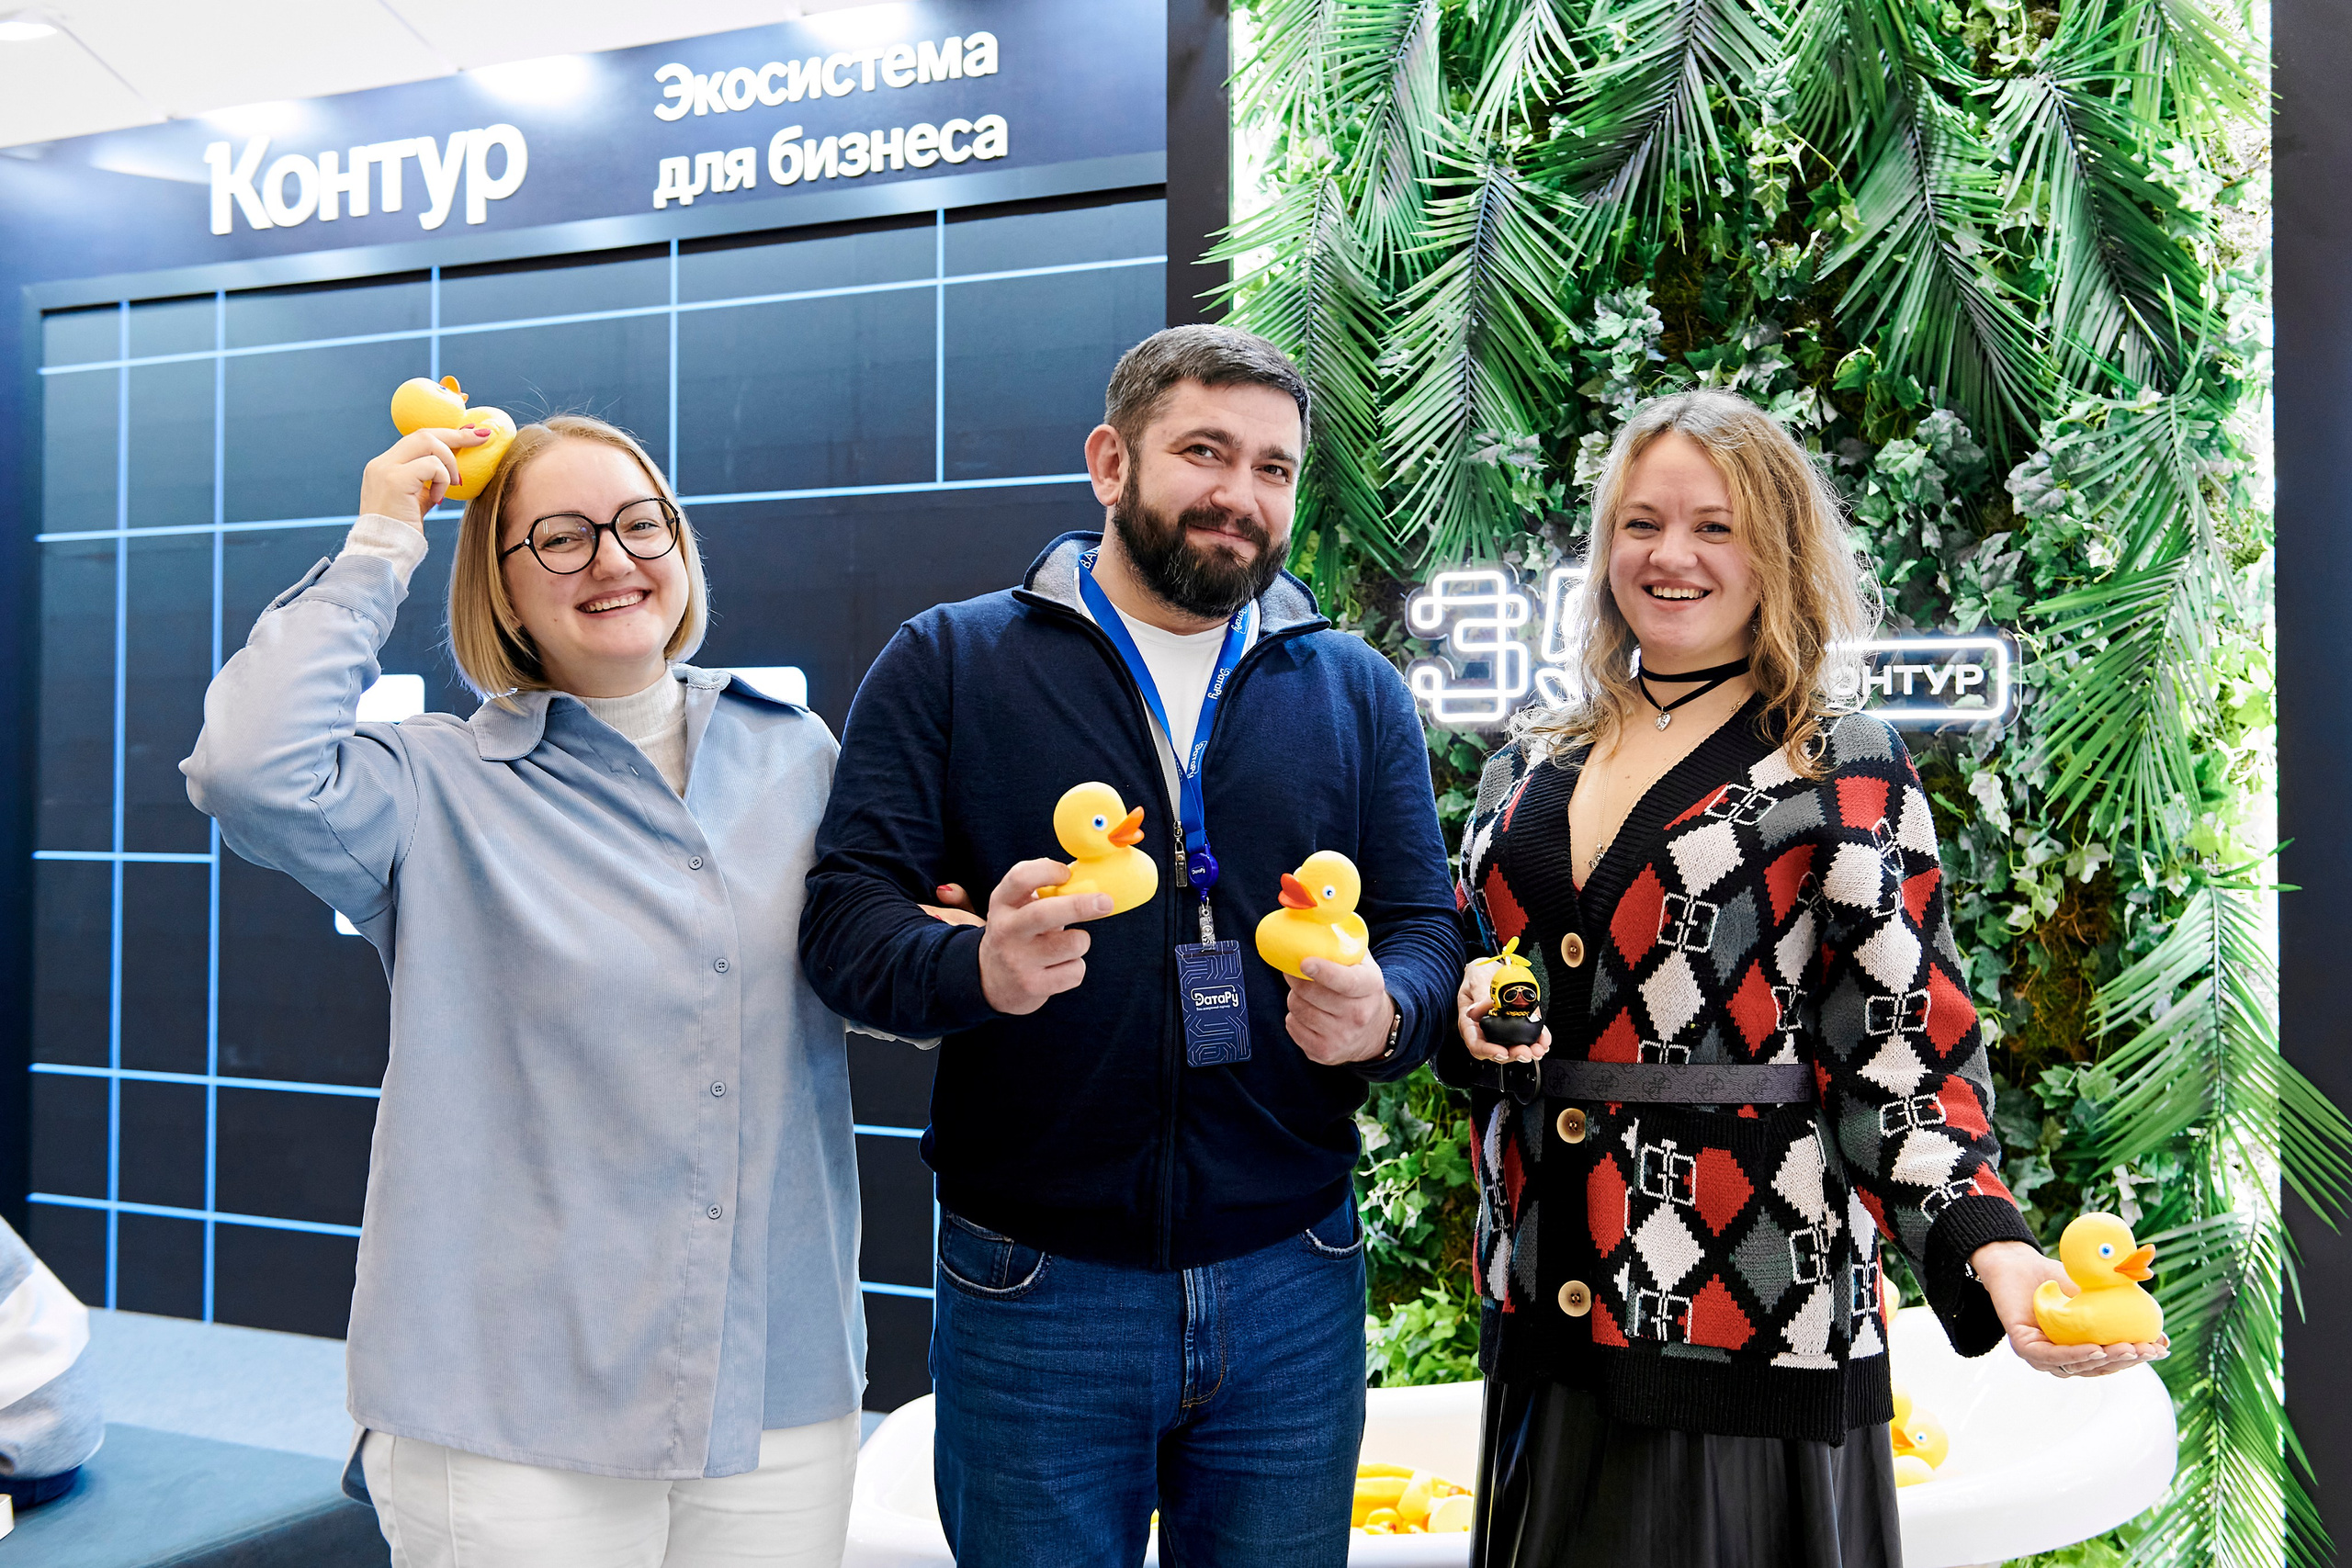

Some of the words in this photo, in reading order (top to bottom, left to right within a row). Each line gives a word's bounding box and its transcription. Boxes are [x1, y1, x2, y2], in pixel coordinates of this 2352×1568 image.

[653, 30, 1000, 121] Экосистема
[203, 122, 529, 236] Контур
[653, 144, 756, 209] для
[768, 113, 1009, 186] бизнеса
